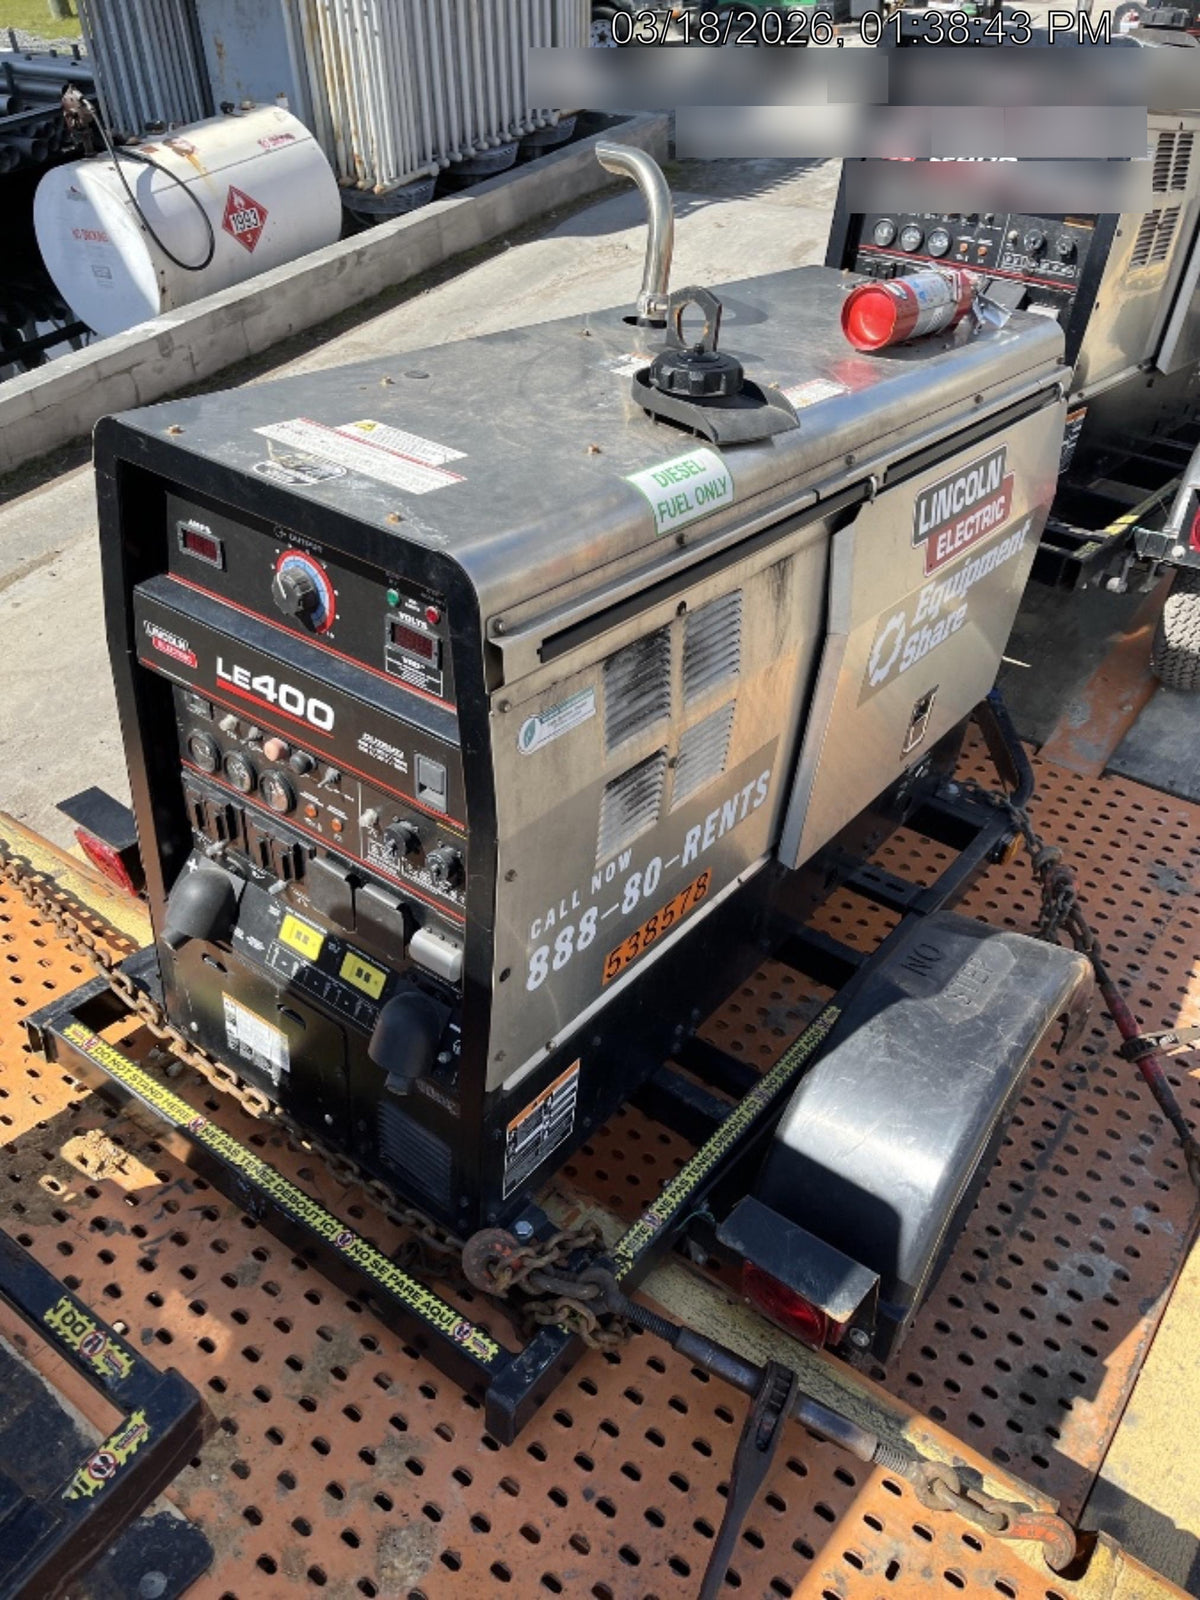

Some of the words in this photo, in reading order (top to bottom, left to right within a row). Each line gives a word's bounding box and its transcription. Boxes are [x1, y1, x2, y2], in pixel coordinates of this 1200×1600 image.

[231, 209, 260, 231] 1993
[652, 459, 707, 489] DIESEL
[657, 492, 694, 523] FUEL
[695, 476, 728, 506] ONLY
[918, 455, 1002, 535] LINCOLN
[936, 495, 1006, 561] ELECTRIC
[912, 517, 1033, 627] Equipment
[899, 602, 969, 674] Share
[216, 656, 335, 732] LE400
[526, 769, 771, 992] 888-80-RENTS
[530, 889, 581, 940] CALL
[590, 848, 632, 895] NOW
[605, 871, 709, 979] 538578
[901, 943, 943, 977] NO
[95, 1045, 111, 1061] DO
[109, 1055, 131, 1075] NOT
[129, 1067, 165, 1100] STAND
[163, 1092, 191, 1121] HERE
[202, 1126, 219, 1142] NE
[217, 1139, 241, 1158] PAS
[273, 1182, 320, 1221] DEBOUT
[319, 1216, 339, 1235] ICI
[656, 1199, 673, 1214] NE
[669, 1178, 690, 1198] PAS
[712, 1111, 749, 1150] DEBOUT
[350, 1243, 371, 1262] NO
[370, 1256, 391, 1276] SE
[387, 1269, 425, 1301] PARE
